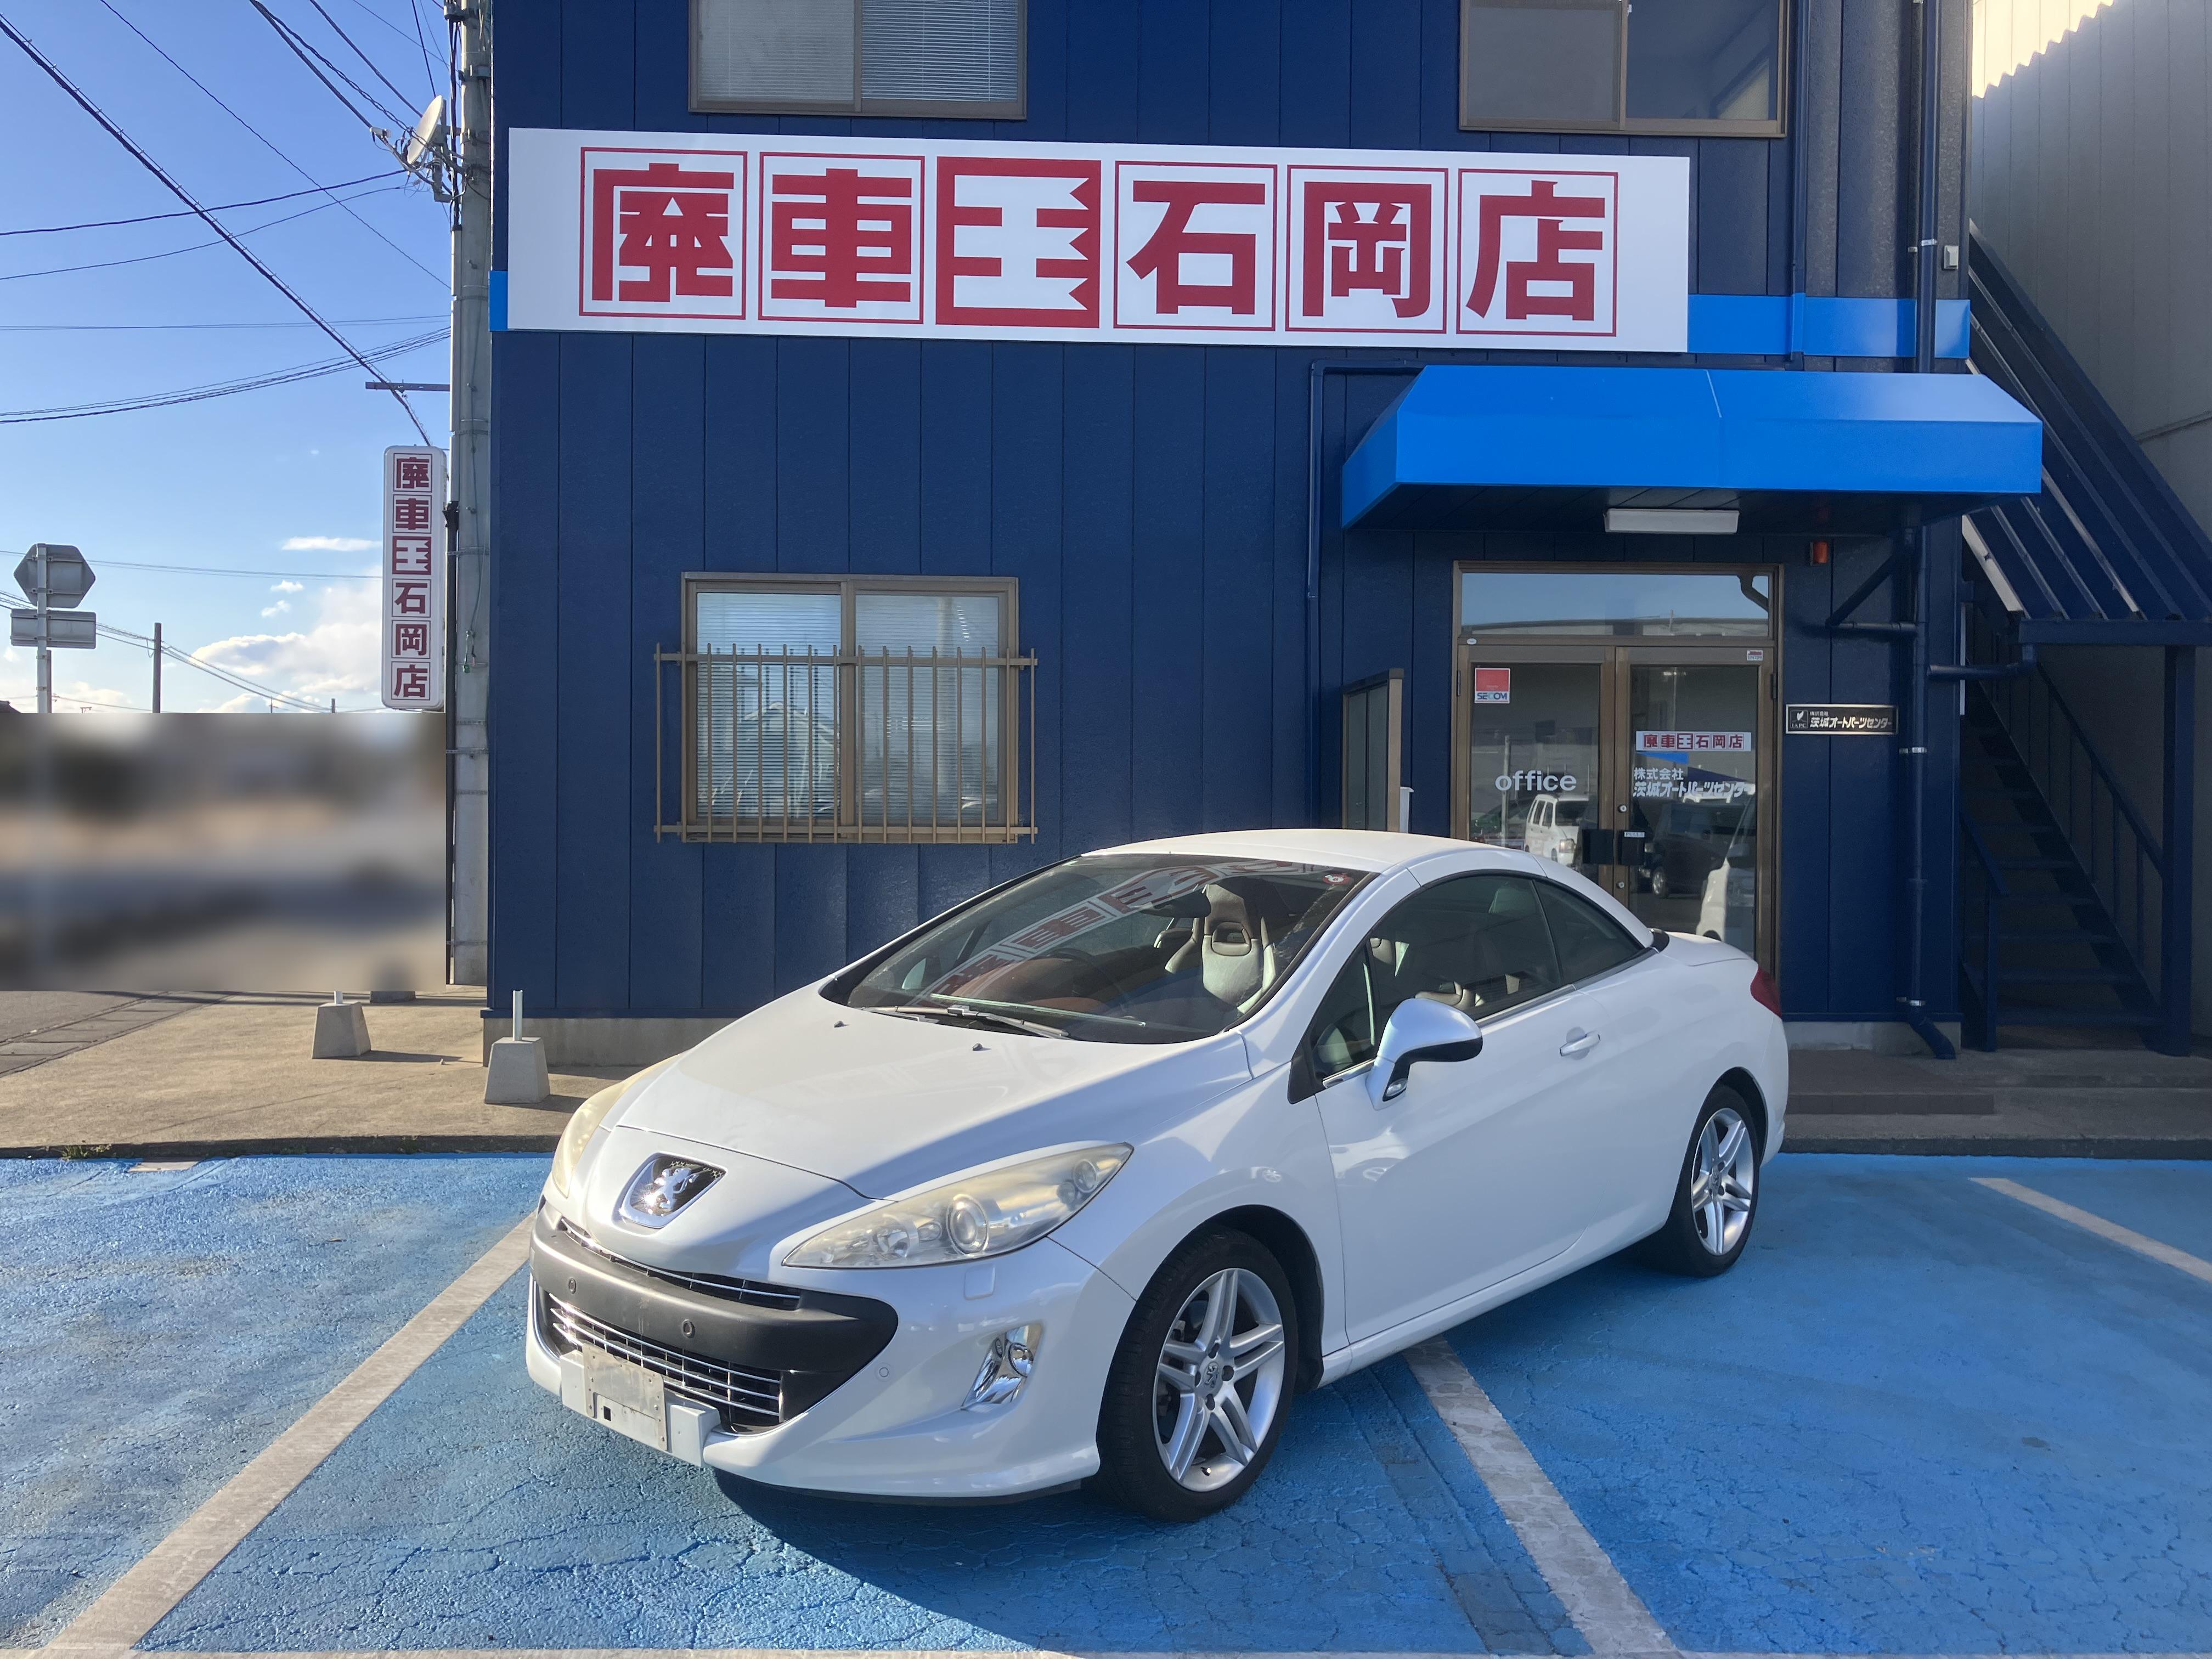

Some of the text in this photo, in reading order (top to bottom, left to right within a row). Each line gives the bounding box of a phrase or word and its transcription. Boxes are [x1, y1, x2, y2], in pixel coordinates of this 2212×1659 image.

[592, 157, 1605, 328] 廃車王石岡店
[393, 456, 432, 698] 廃車王石岡店
[1644, 733, 1743, 749] 廃車王石岡店
[1495, 770, 1577, 791] office
[1634, 768, 1684, 780] 株式会社
